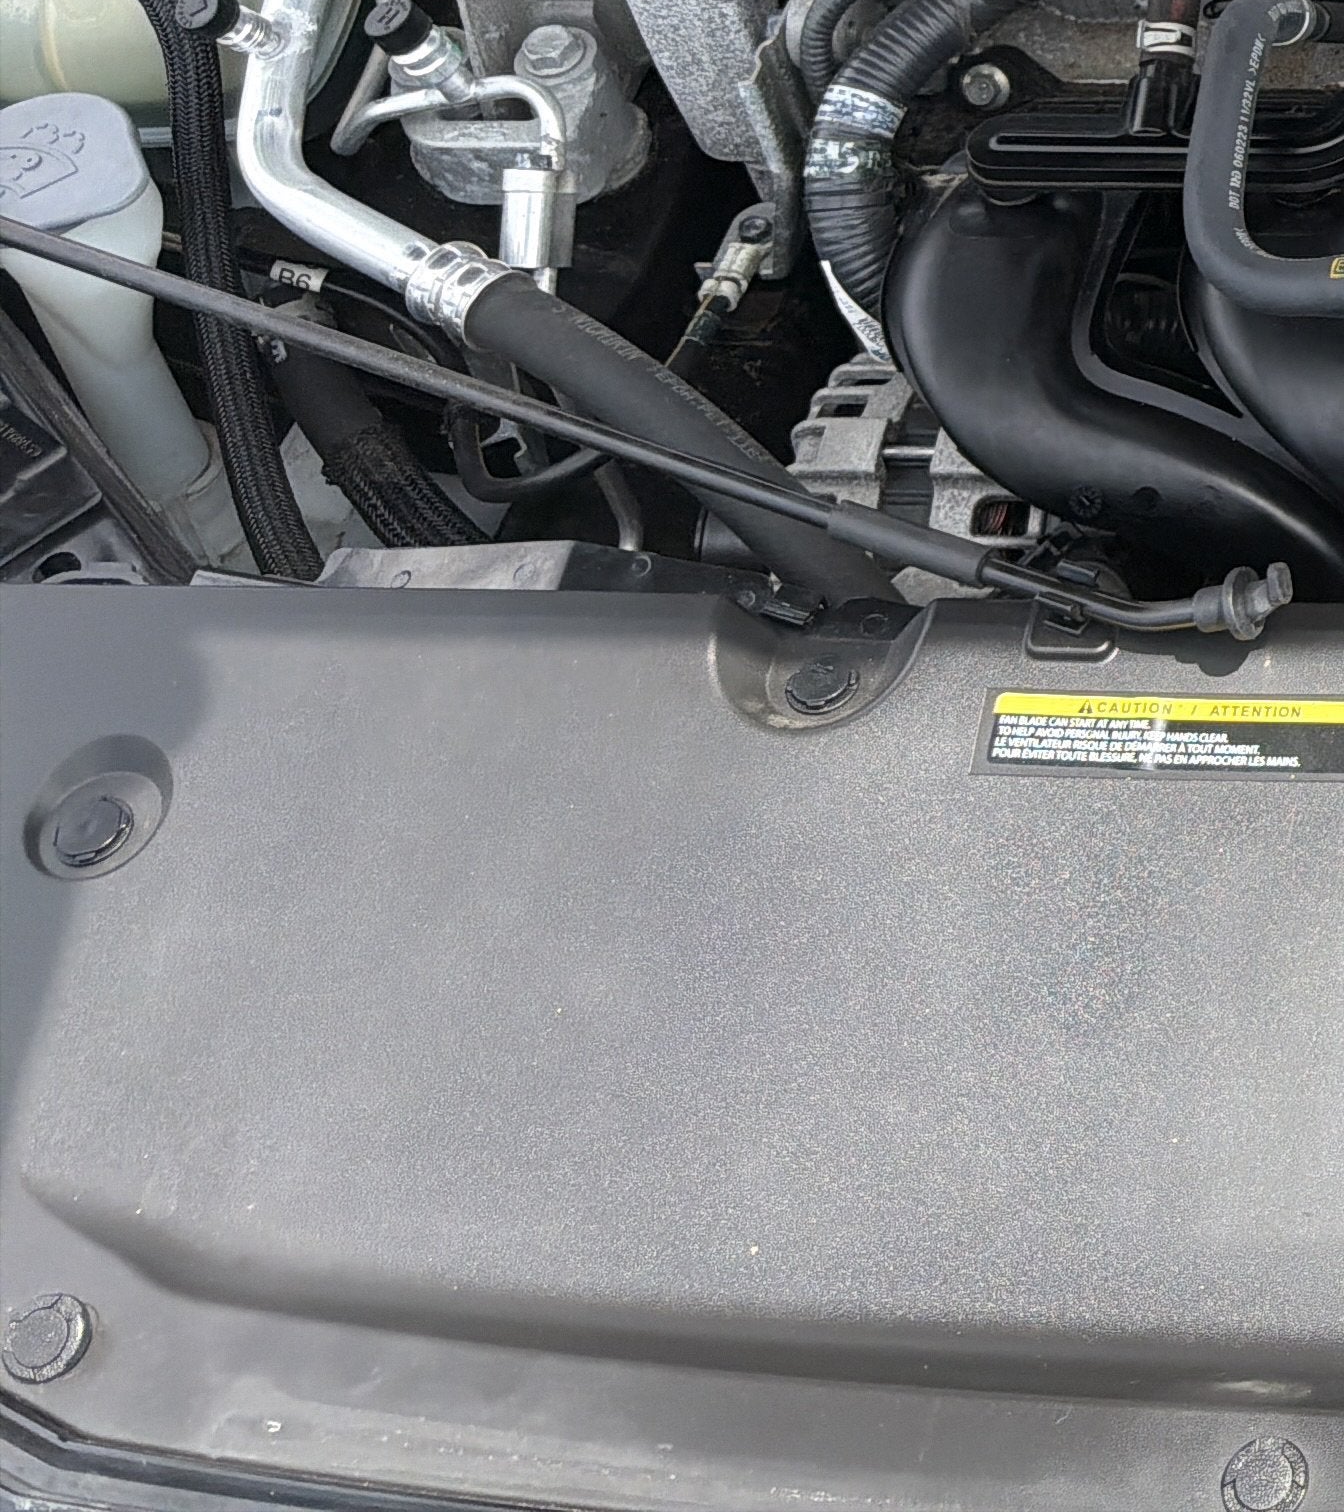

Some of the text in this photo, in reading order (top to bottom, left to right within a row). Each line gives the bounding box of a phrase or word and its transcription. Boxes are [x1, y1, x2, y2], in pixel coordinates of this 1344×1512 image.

[377, 7, 400, 25] H
[279, 268, 312, 290] B6
[1097, 703, 1173, 715] CAUTION
[1210, 705, 1302, 718] ATTENTION
[999, 715, 1151, 730] FAN BLADE CAN START AT ANY TIME.
[999, 726, 1012, 735] TO
[1012, 727, 1035, 736] HELP
[1036, 728, 1064, 738] AVOID
[1065, 729, 1110, 739] PERSONAL
[1143, 731, 1166, 741] KEEP
[1166, 732, 1198, 742] HANDS
[1199, 733, 1228, 743] CLEAR.
[994, 737, 1008, 747] LE
[1008, 738, 1072, 749] VENTILATEUR
[1073, 740, 1107, 751] RISQUE
[1109, 742, 1123, 751] DE
[1125, 741, 1177, 753] DÉMARRER
[1179, 742, 1186, 753] À
[1187, 745, 1213, 754] TOUT
[992, 748, 1021, 759] POUR
[1022, 748, 1055, 760] ÉVITER
[1056, 751, 1088, 761] TOUTE
[1138, 753, 1155, 764] NE
[1155, 754, 1173, 765] PAS
[1174, 755, 1189, 765] EN
[1189, 756, 1247, 766] APPROCHER
[1249, 757, 1265, 767] LES
[1267, 757, 1300, 768] MAINS.
